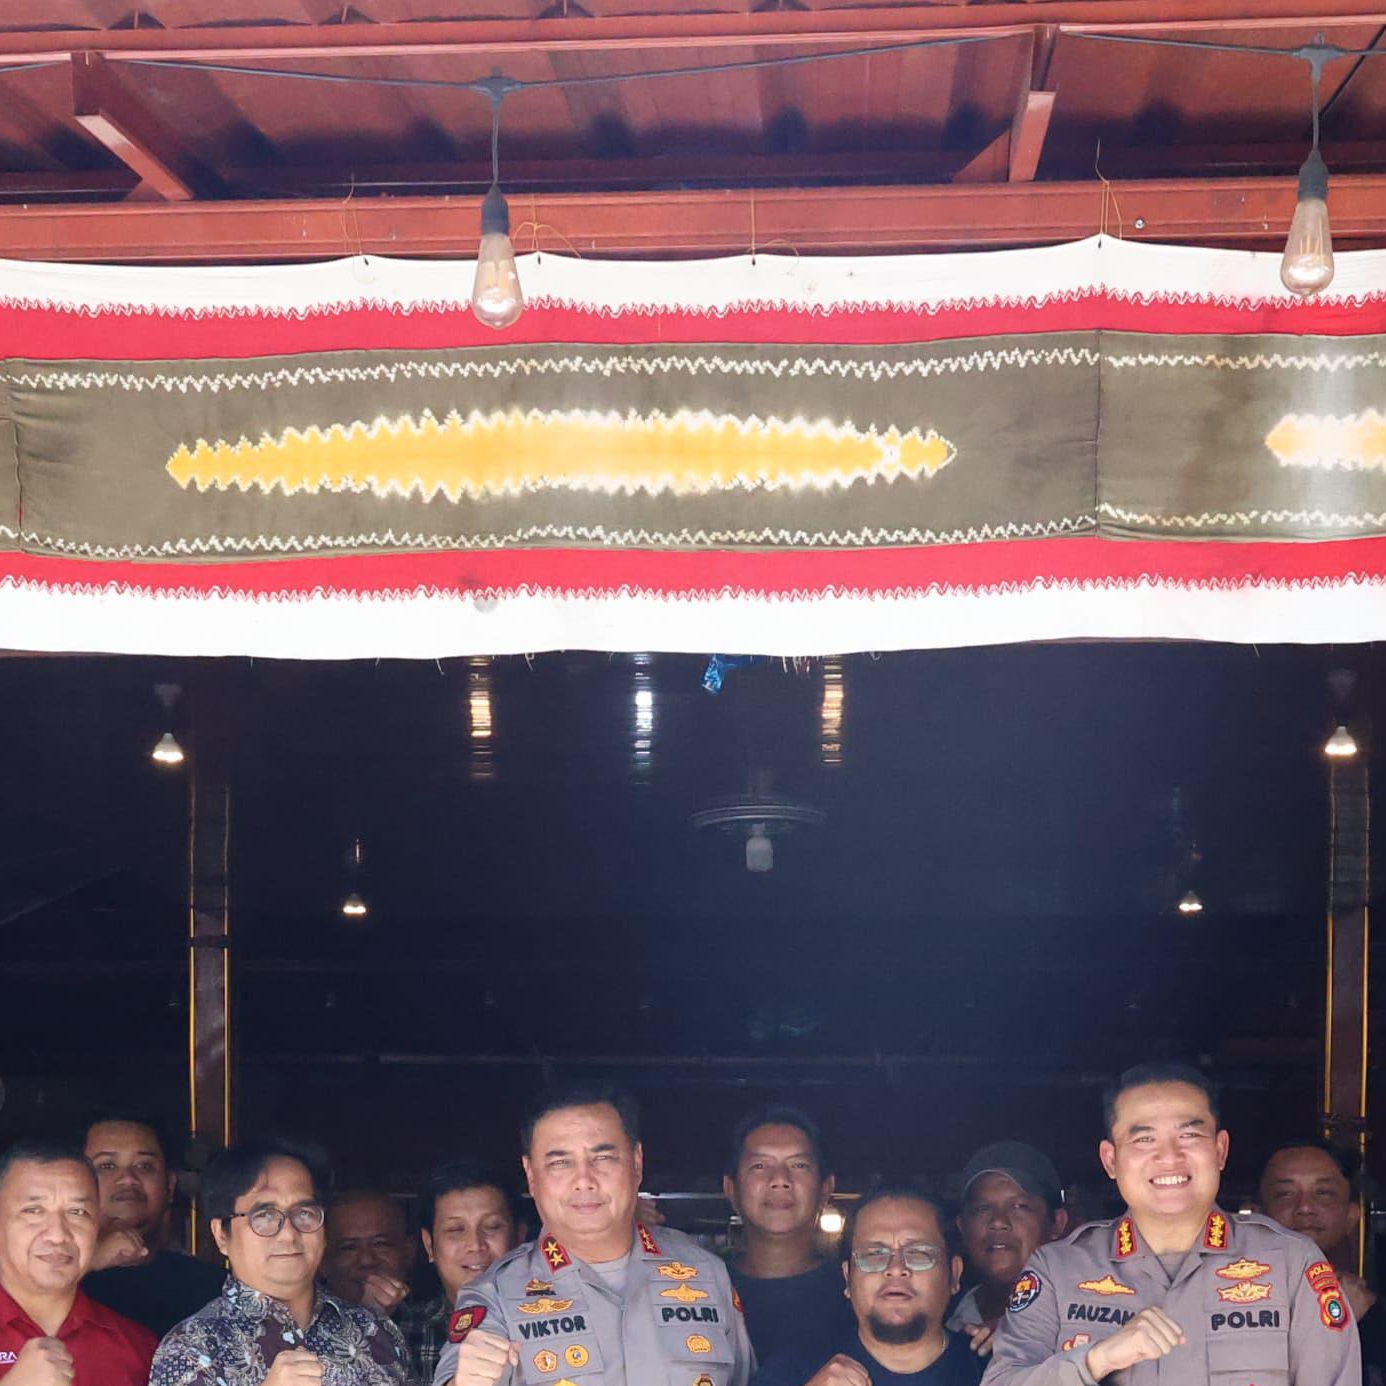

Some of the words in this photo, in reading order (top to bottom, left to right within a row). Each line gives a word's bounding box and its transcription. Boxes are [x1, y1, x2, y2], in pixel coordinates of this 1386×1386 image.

[661, 1306, 719, 1323] POLRI
[1211, 1310, 1281, 1331] POLRI
[518, 1315, 587, 1340] VIKTOR
